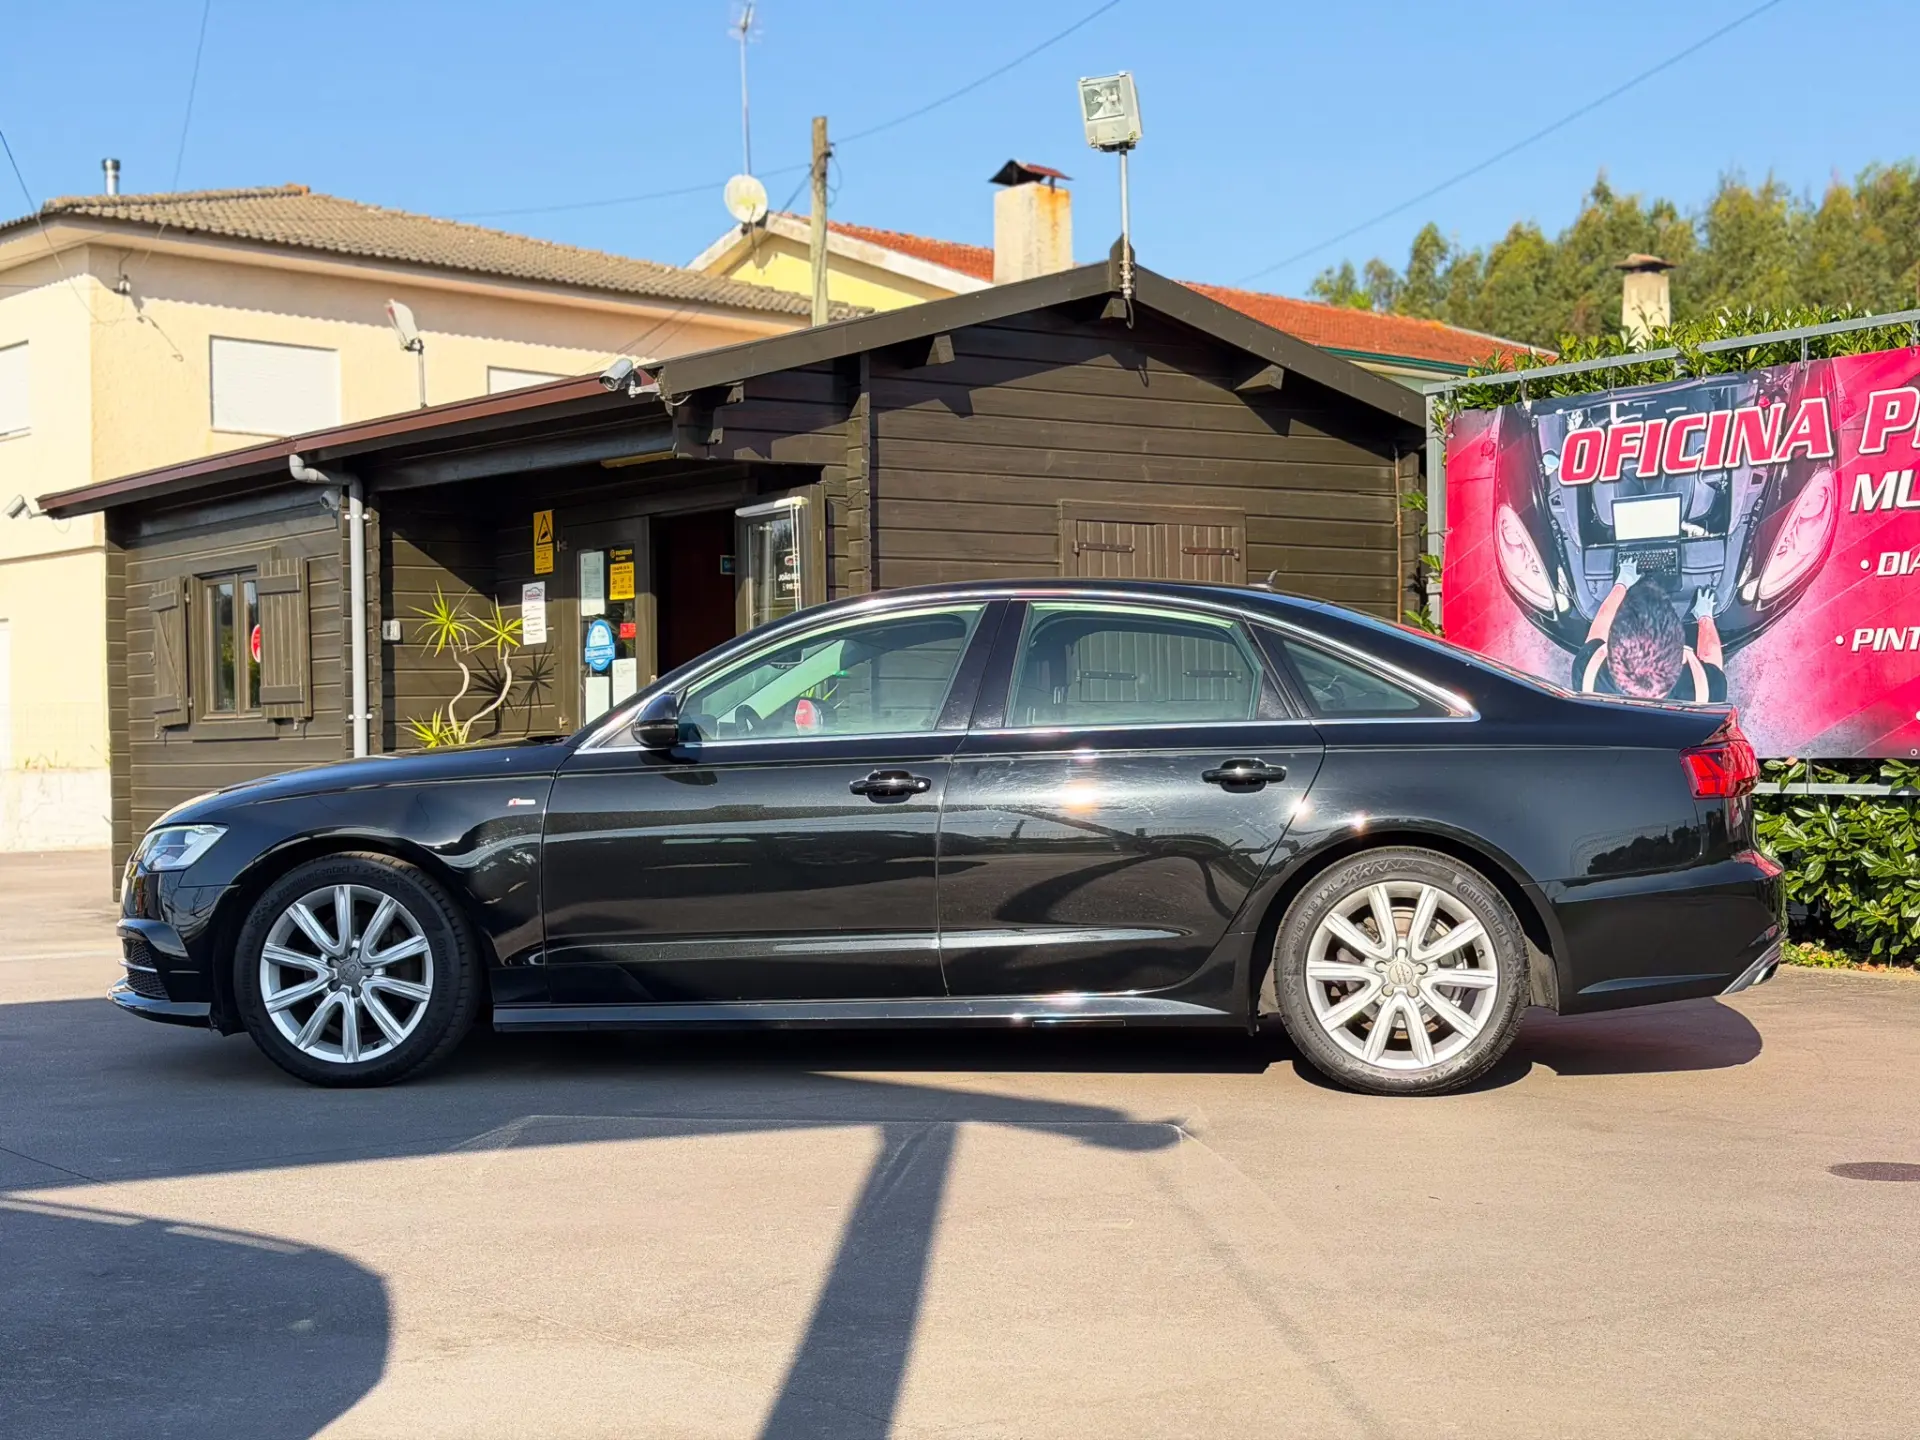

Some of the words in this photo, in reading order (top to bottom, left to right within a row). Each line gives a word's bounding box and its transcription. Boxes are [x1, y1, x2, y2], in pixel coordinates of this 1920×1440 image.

[1558, 397, 1834, 486] OFICINA
[1859, 386, 1920, 454] P
[1456, 881, 1508, 937] Continental
